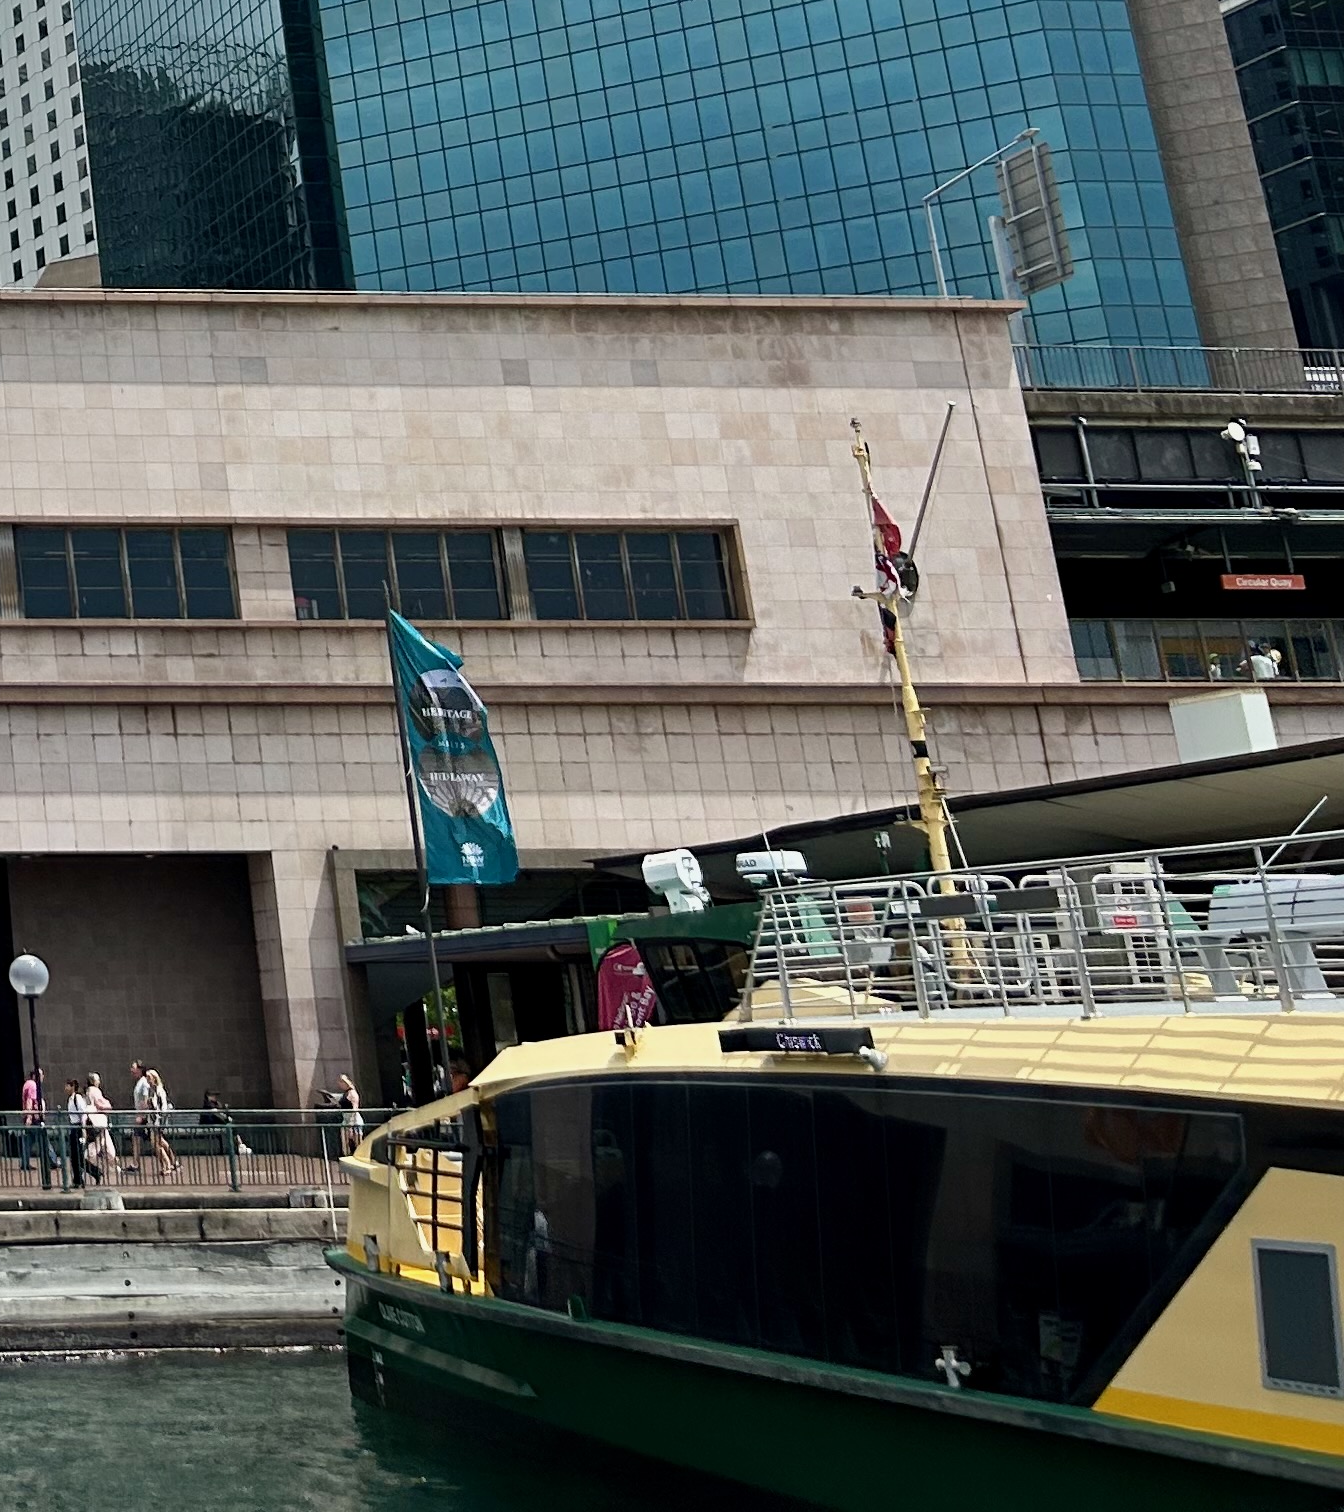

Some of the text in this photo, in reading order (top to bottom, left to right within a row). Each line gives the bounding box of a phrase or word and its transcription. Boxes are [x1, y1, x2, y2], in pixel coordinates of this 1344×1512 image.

[1235, 577, 1293, 588] Circular Quay
[421, 707, 473, 719] HERITAGE
